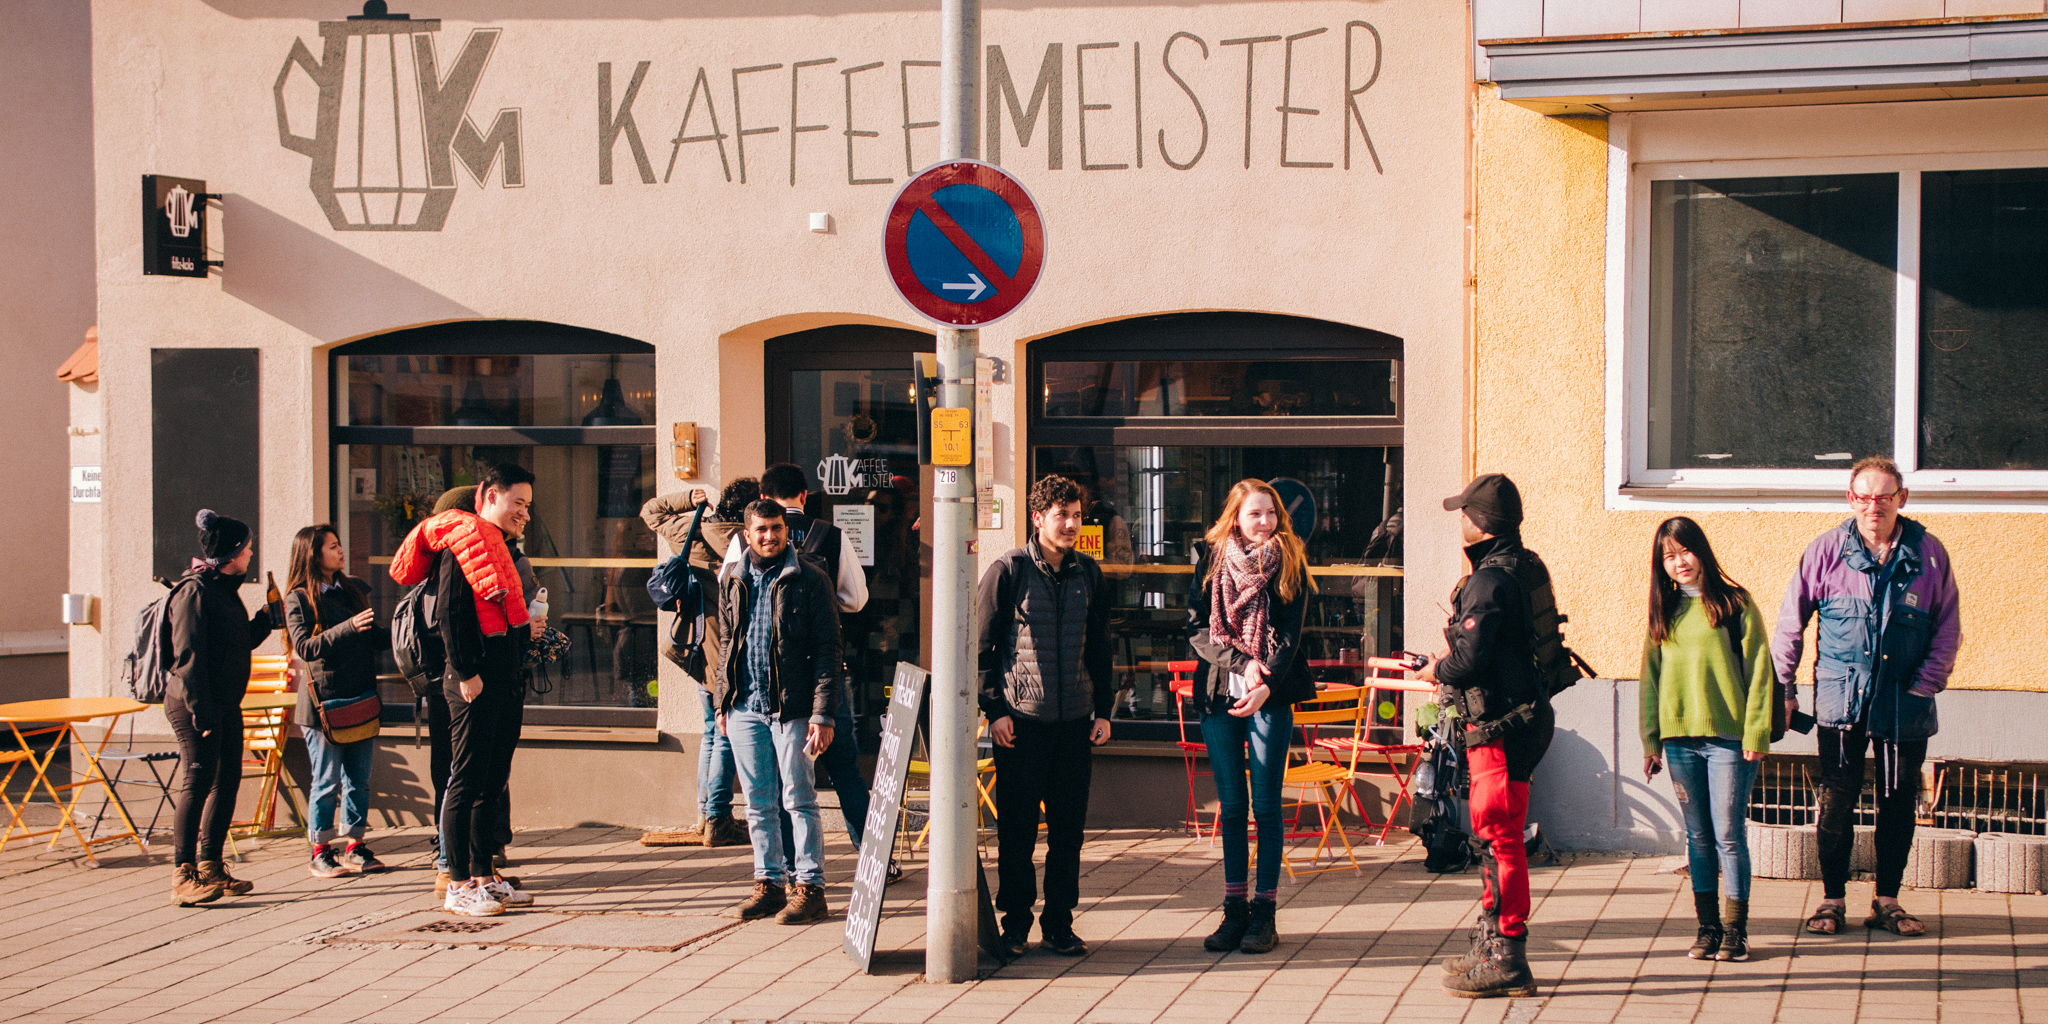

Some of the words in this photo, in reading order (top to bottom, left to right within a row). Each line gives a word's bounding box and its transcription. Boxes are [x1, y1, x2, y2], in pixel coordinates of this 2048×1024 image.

[598, 57, 942, 187] KAFFEE
[986, 20, 1383, 175] MEISTER
[958, 420, 969, 429] 63
[82, 470, 101, 482] Keine
[844, 458, 888, 479] KAFFEE
[850, 472, 894, 489] MEISTER
[940, 470, 956, 483] 218
[882, 713, 901, 766] Panini
[875, 757, 898, 804] Belegte
[866, 793, 887, 840] Brote
[856, 842, 884, 902] Kuchen
